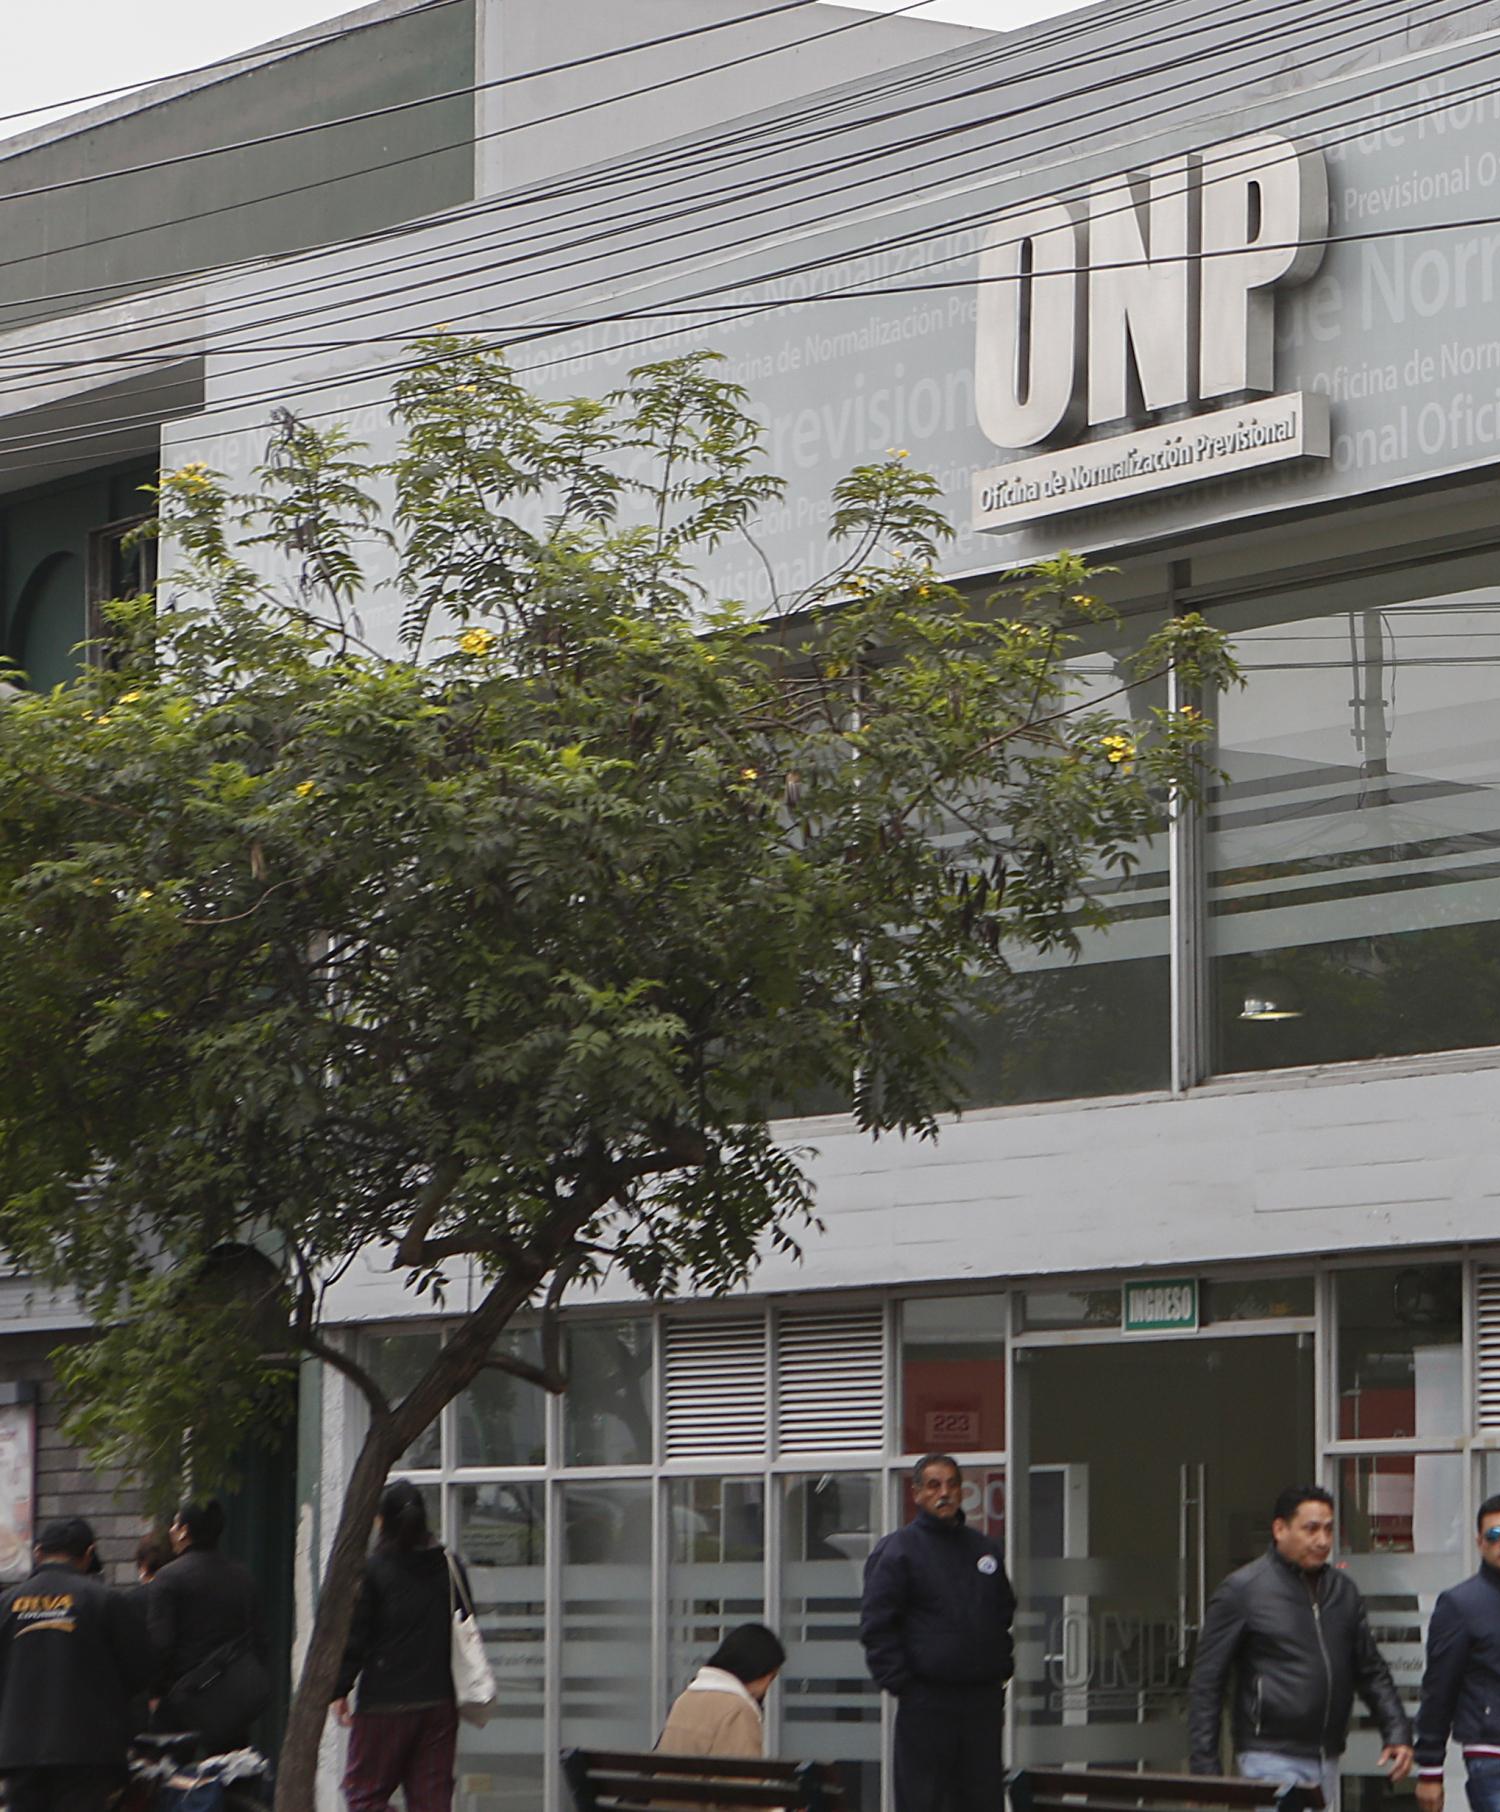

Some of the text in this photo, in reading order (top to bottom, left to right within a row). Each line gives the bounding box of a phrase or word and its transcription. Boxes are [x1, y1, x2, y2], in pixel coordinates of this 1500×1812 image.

[1357, 92, 1405, 156] de
[1344, 154, 1471, 222] Previsional
[763, 212, 982, 323] Normalizació
[975, 133, 1328, 449] ONP
[776, 340, 801, 374] de
[804, 304, 943, 367] Normalización
[949, 296, 978, 327] Pre
[1312, 360, 1398, 403] Oficina
[1404, 348, 1435, 387] de
[745, 362, 975, 476] Prevision
[980, 410, 1297, 512] Oficina de Normalización Previsional
[1128, 1286, 1192, 1323] INGRESO
